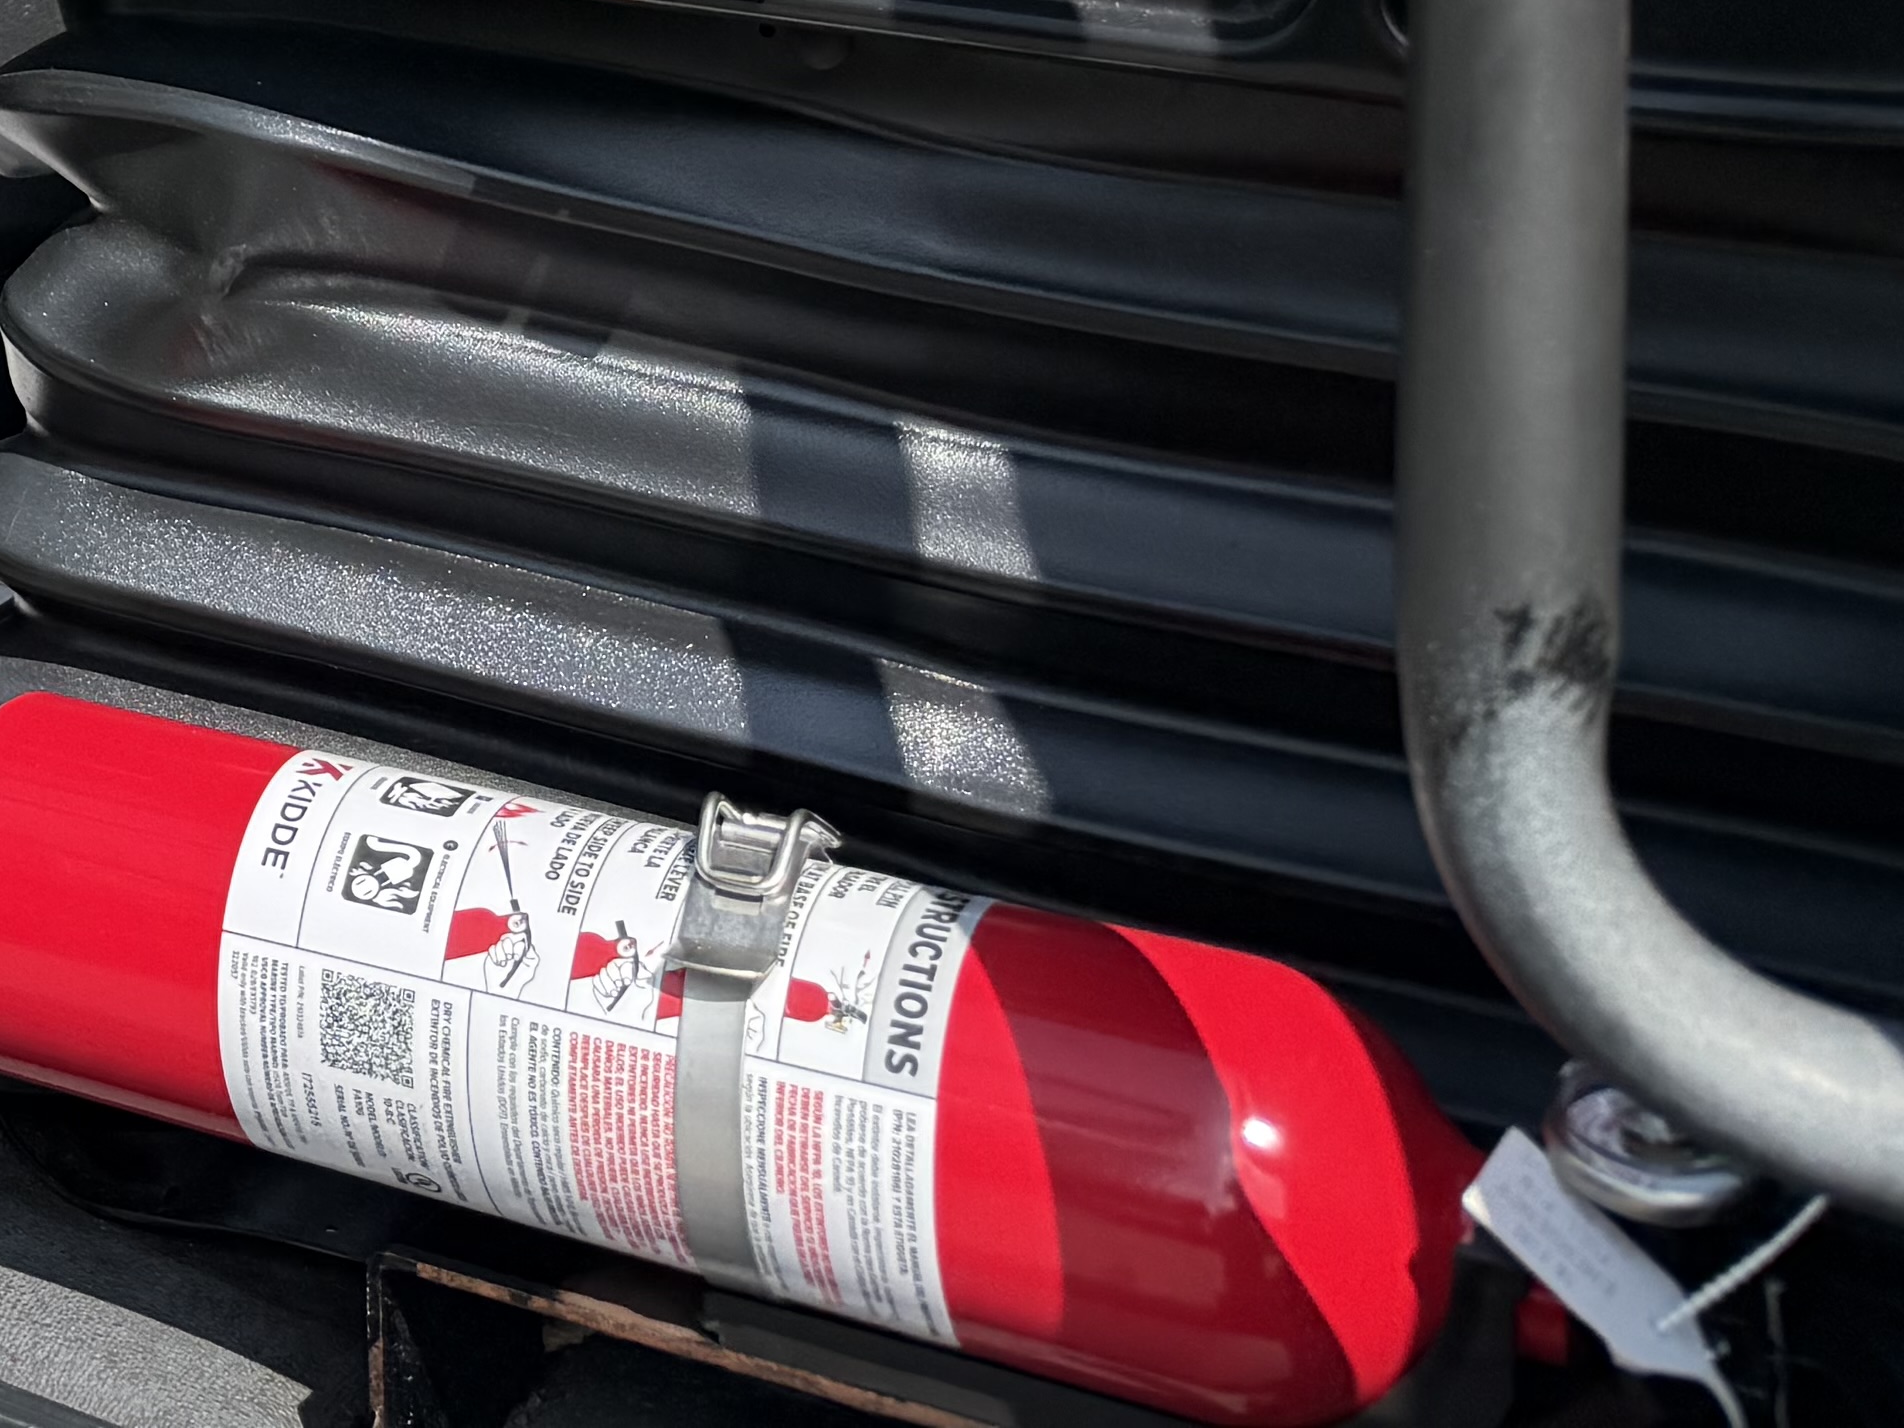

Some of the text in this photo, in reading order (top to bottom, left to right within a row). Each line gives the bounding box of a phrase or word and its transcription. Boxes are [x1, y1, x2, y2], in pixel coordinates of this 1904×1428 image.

[261, 779, 318, 870] KIDDE
[543, 831, 581, 882] DE LADO
[582, 834, 607, 860] SIDE
[644, 854, 664, 870] LA
[573, 859, 594, 878] TO
[659, 864, 690, 903] LEVER
[560, 880, 585, 916] SIDE
[789, 880, 814, 909] BASE
